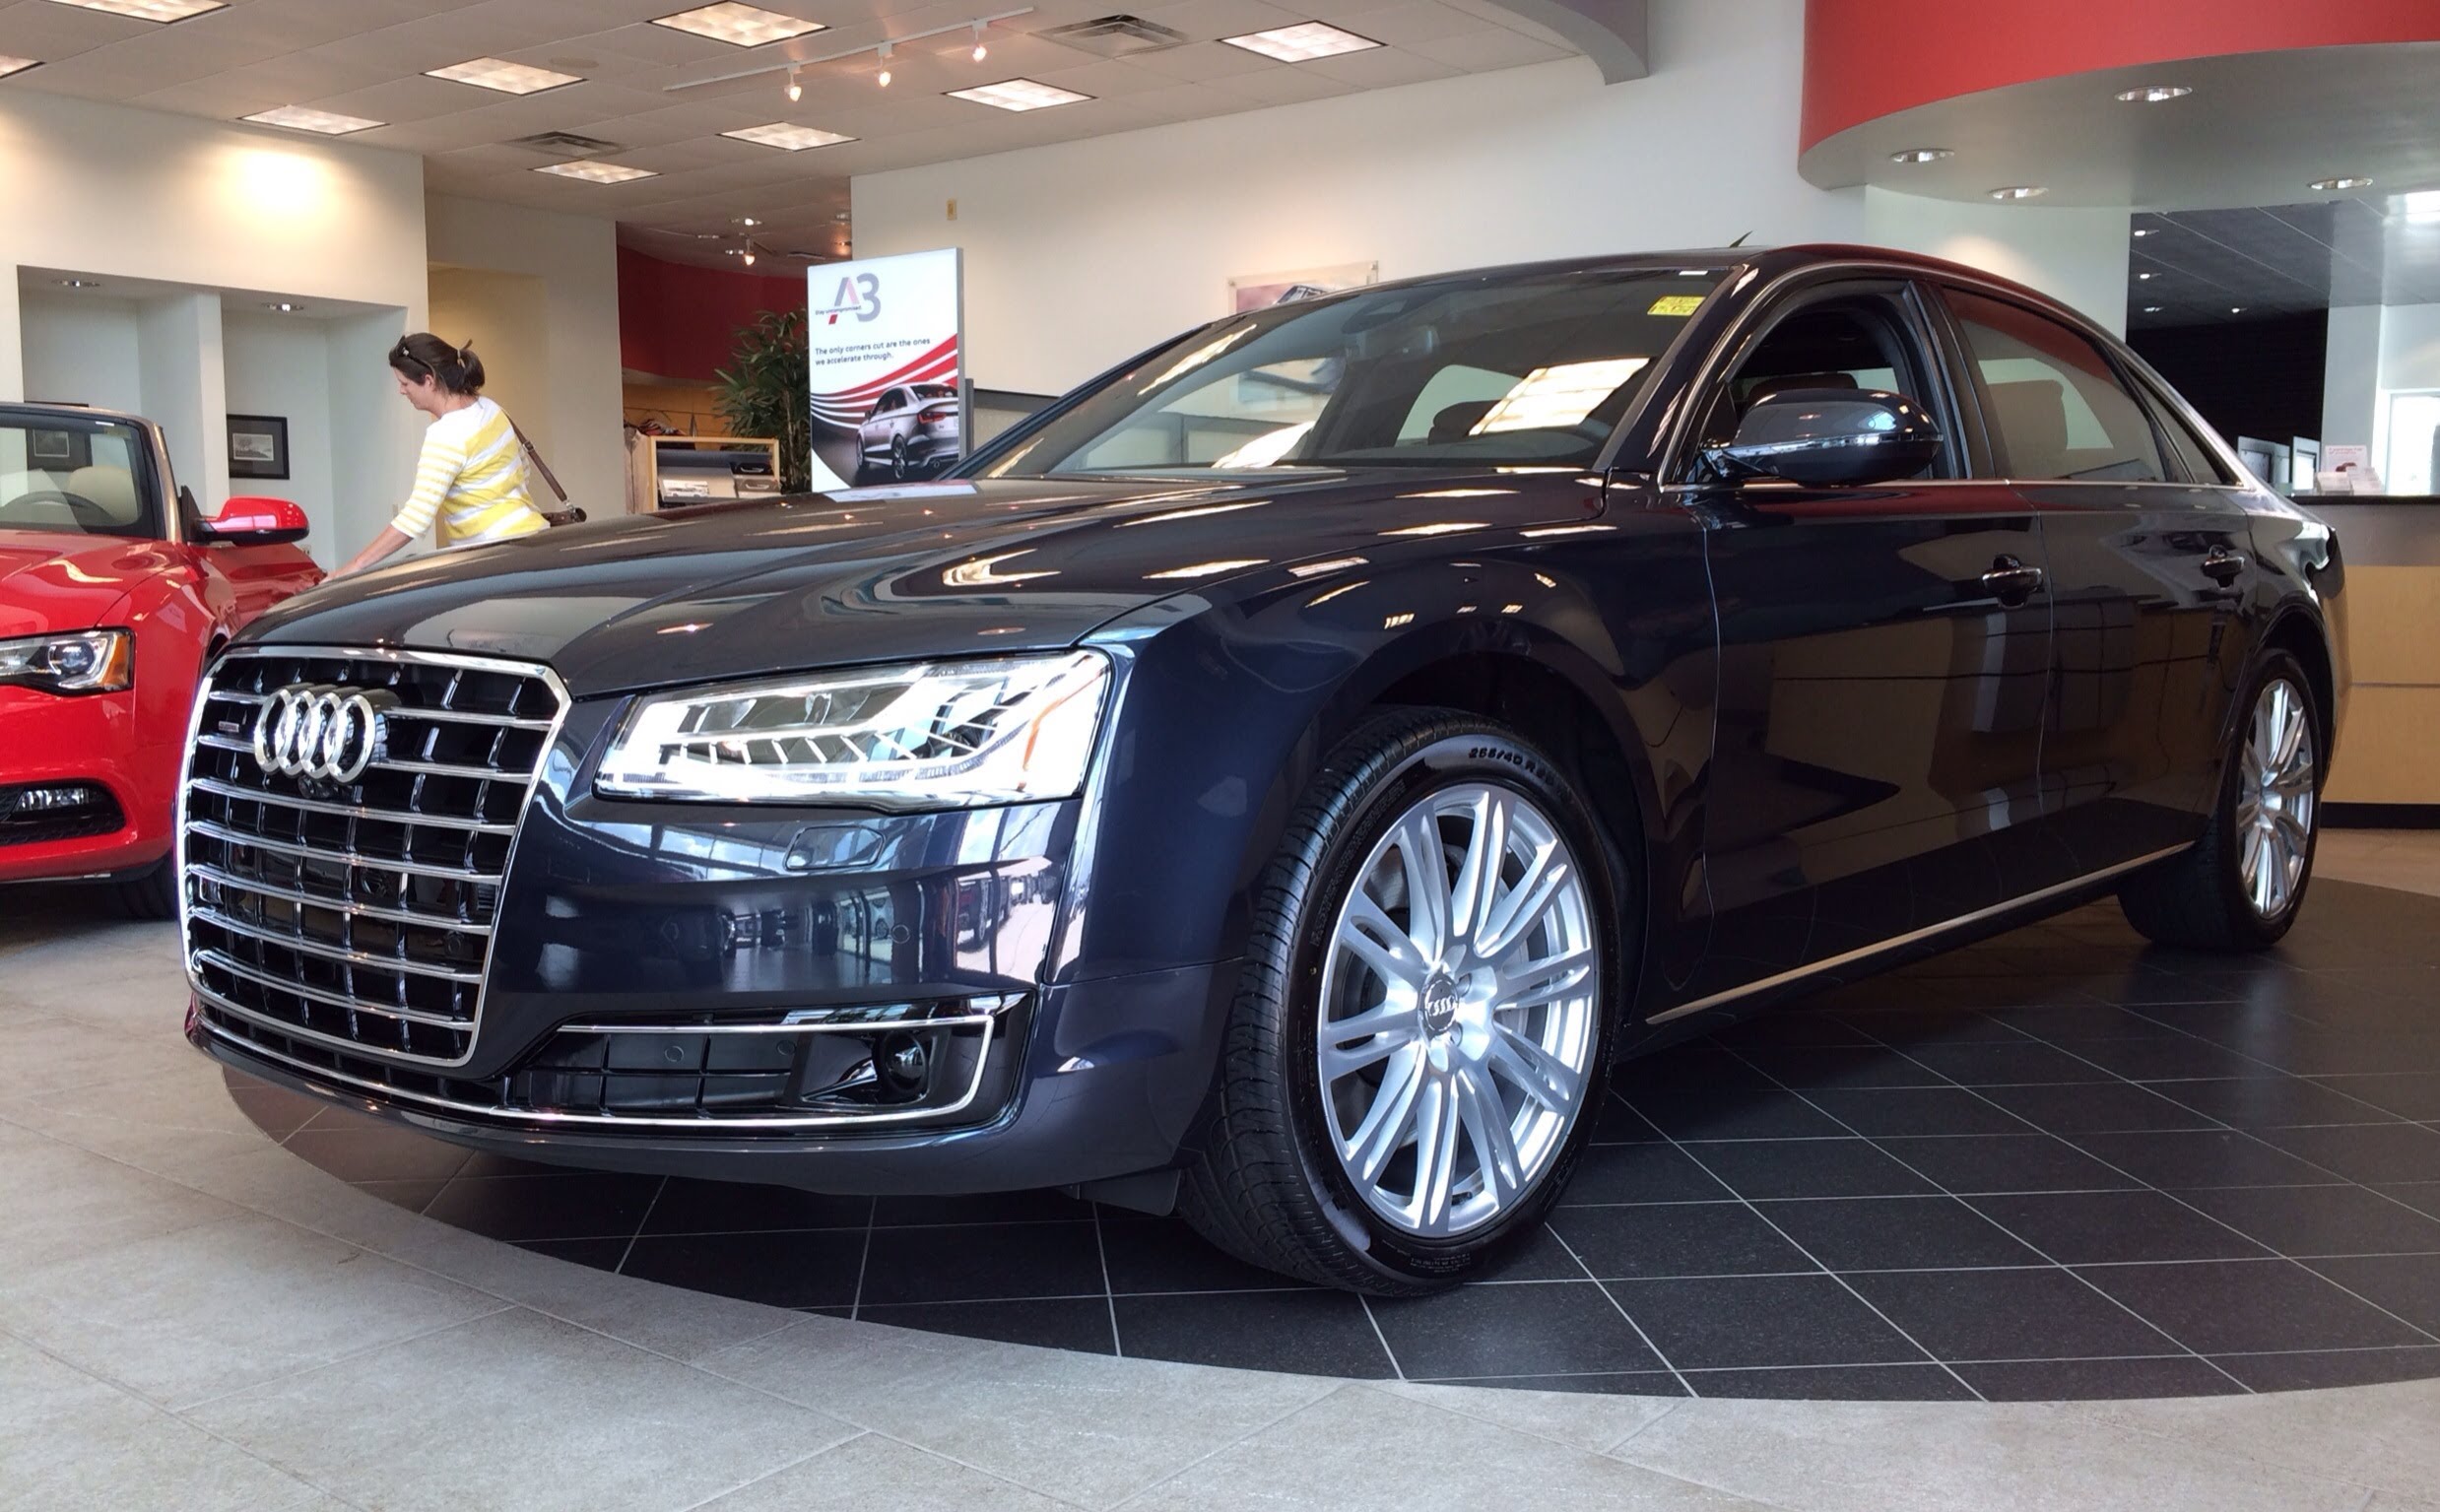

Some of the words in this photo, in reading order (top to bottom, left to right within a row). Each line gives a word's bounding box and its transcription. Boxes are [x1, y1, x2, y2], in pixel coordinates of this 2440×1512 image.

[828, 273, 881, 325] A3
[828, 346, 843, 355] only
[845, 344, 872, 353] corners
[826, 355, 862, 364] accelerate
[863, 352, 893, 362] through.
